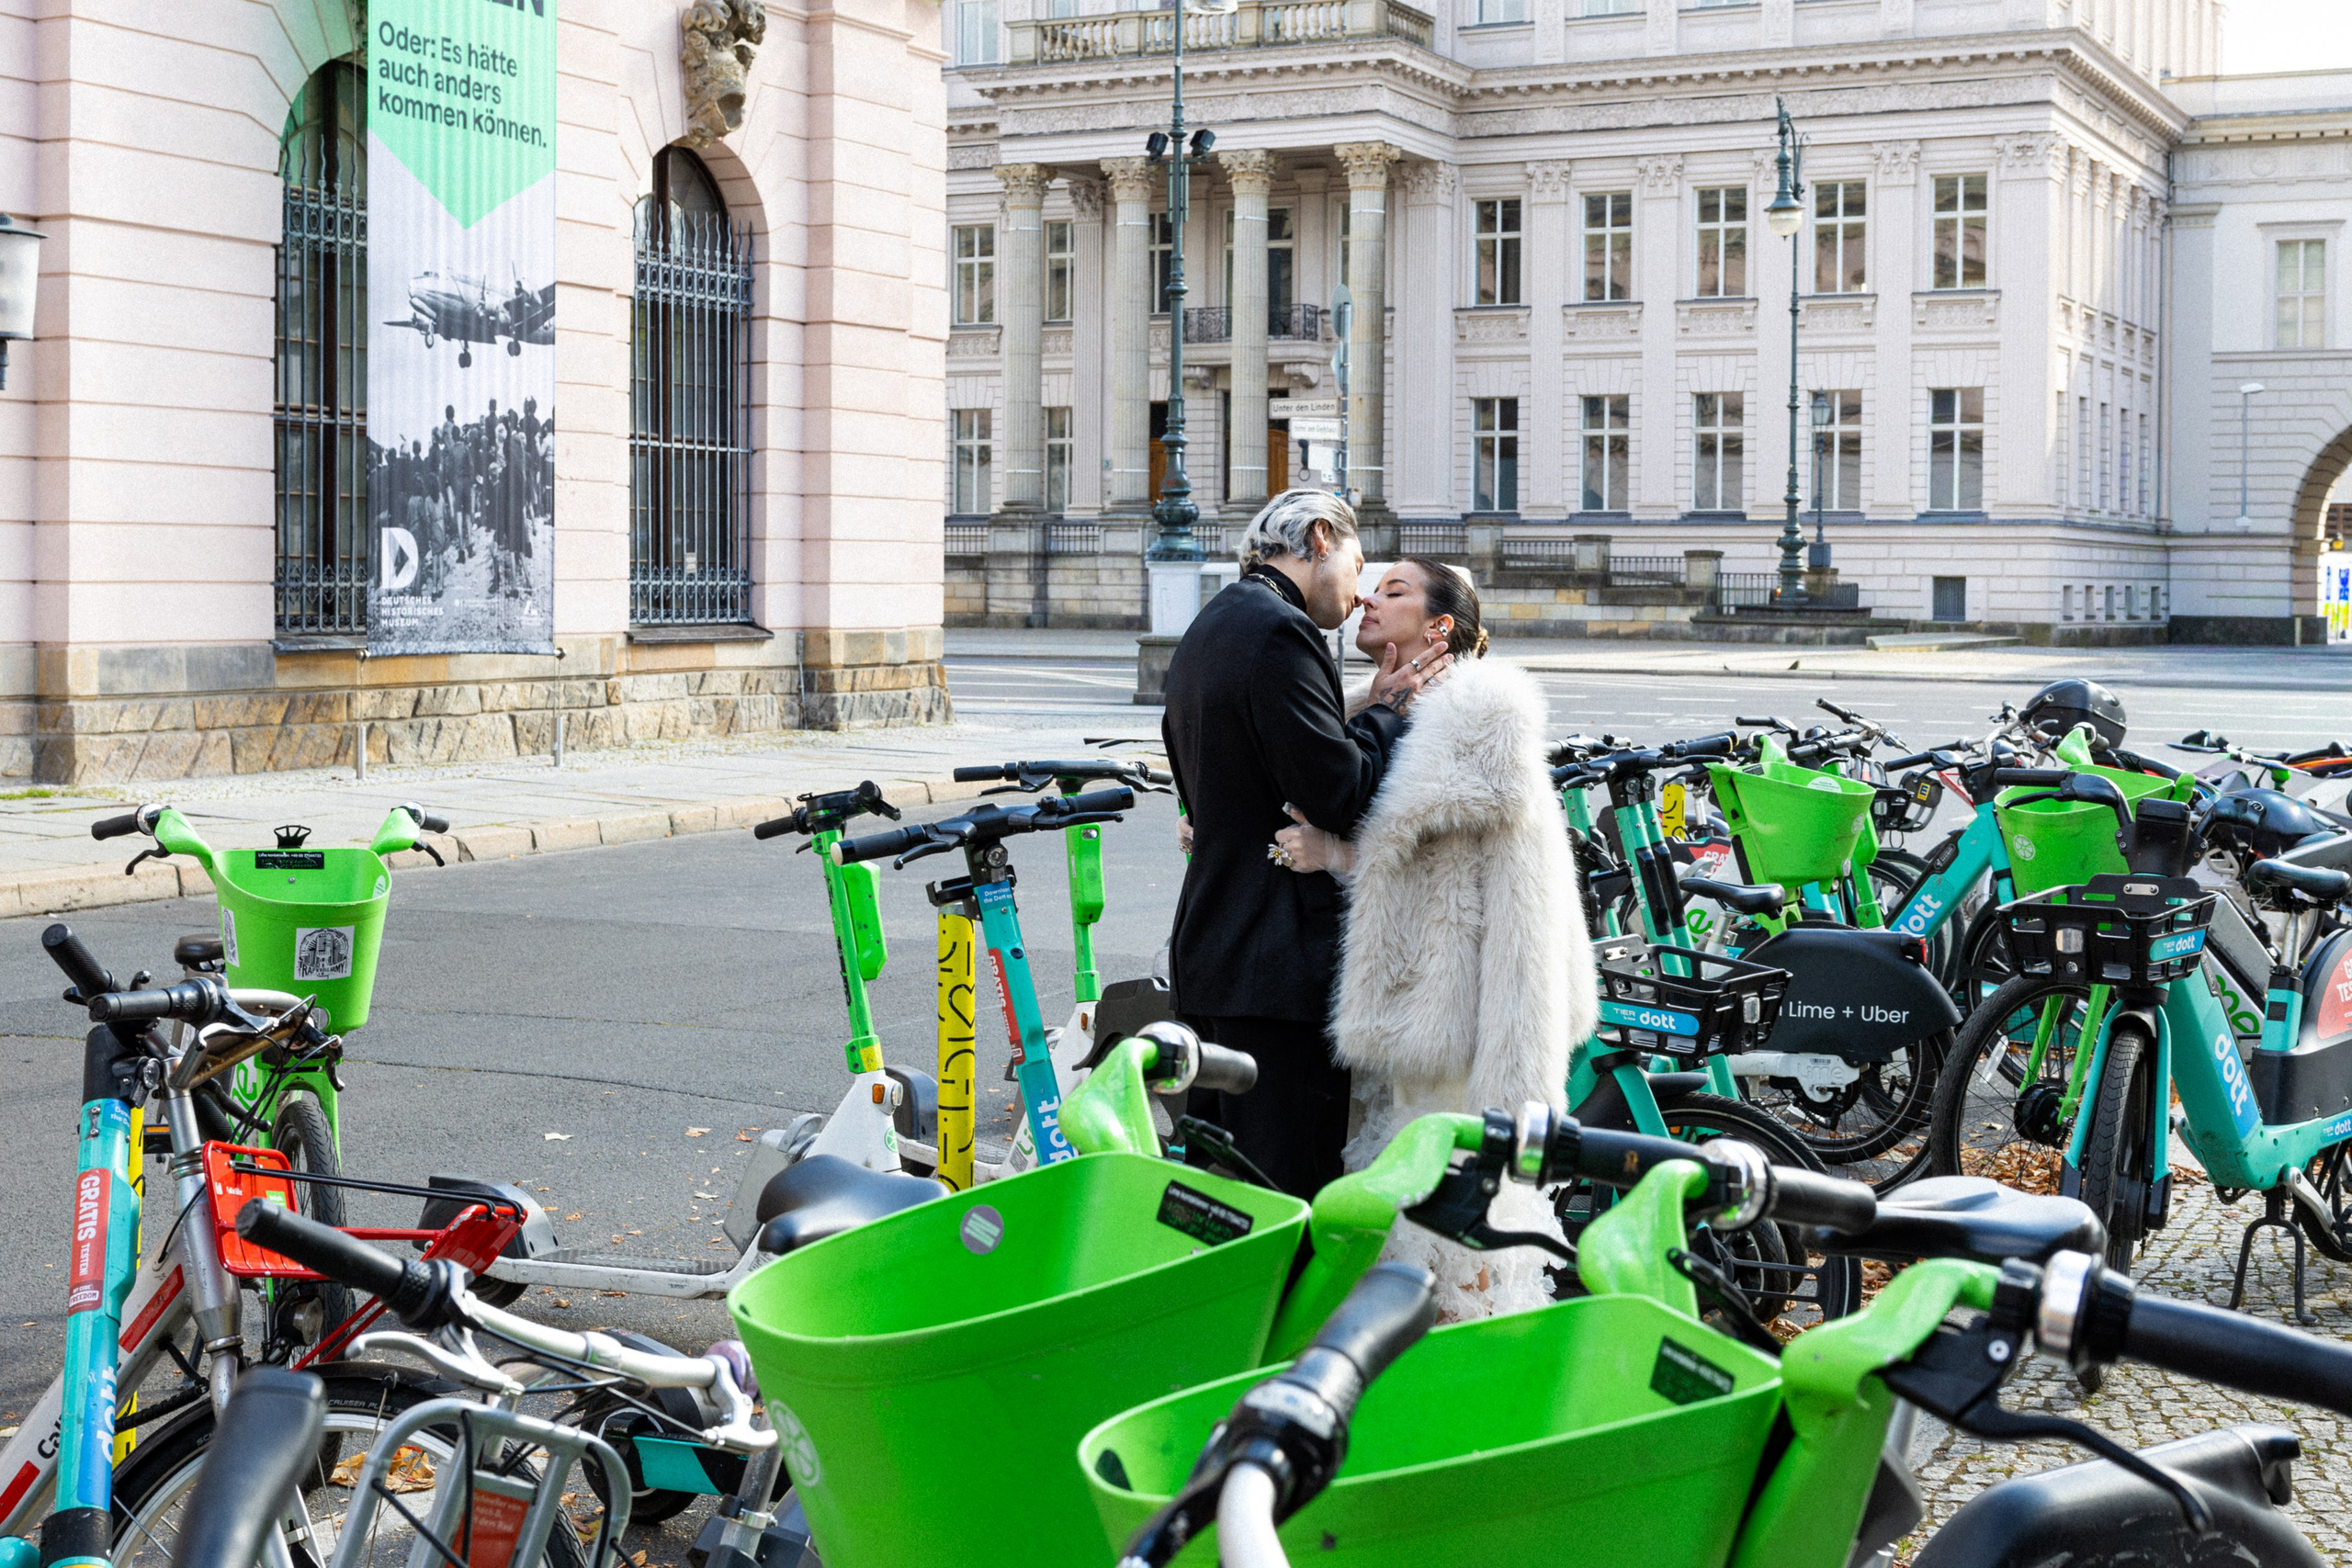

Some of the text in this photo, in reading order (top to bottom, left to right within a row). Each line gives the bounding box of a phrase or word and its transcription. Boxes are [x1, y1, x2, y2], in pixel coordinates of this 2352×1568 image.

[379, 21, 517, 77] Oder: Es hätte
[379, 58, 502, 105] auch anders
[379, 85, 548, 148] kommen können.
[1272, 402, 1336, 412] Unter den Linden
[381, 596, 432, 605] DEUTSCHES
[381, 607, 444, 616] HISTORISCHES
[381, 617, 419, 626] MUSEUM
[2176, 934, 2196, 953] dott
[1613, 1008, 1677, 1030] TIER dott
[1789, 1000, 1836, 1020] Lime
[1842, 1006, 1854, 1018] +
[1861, 1005, 1910, 1023] Uber
[2214, 1033, 2248, 1117] dott
[2335, 1118, 2352, 1136] dott
[77, 1175, 101, 1242] GRATIS
[328, 1399, 366, 1407] CRUISER
